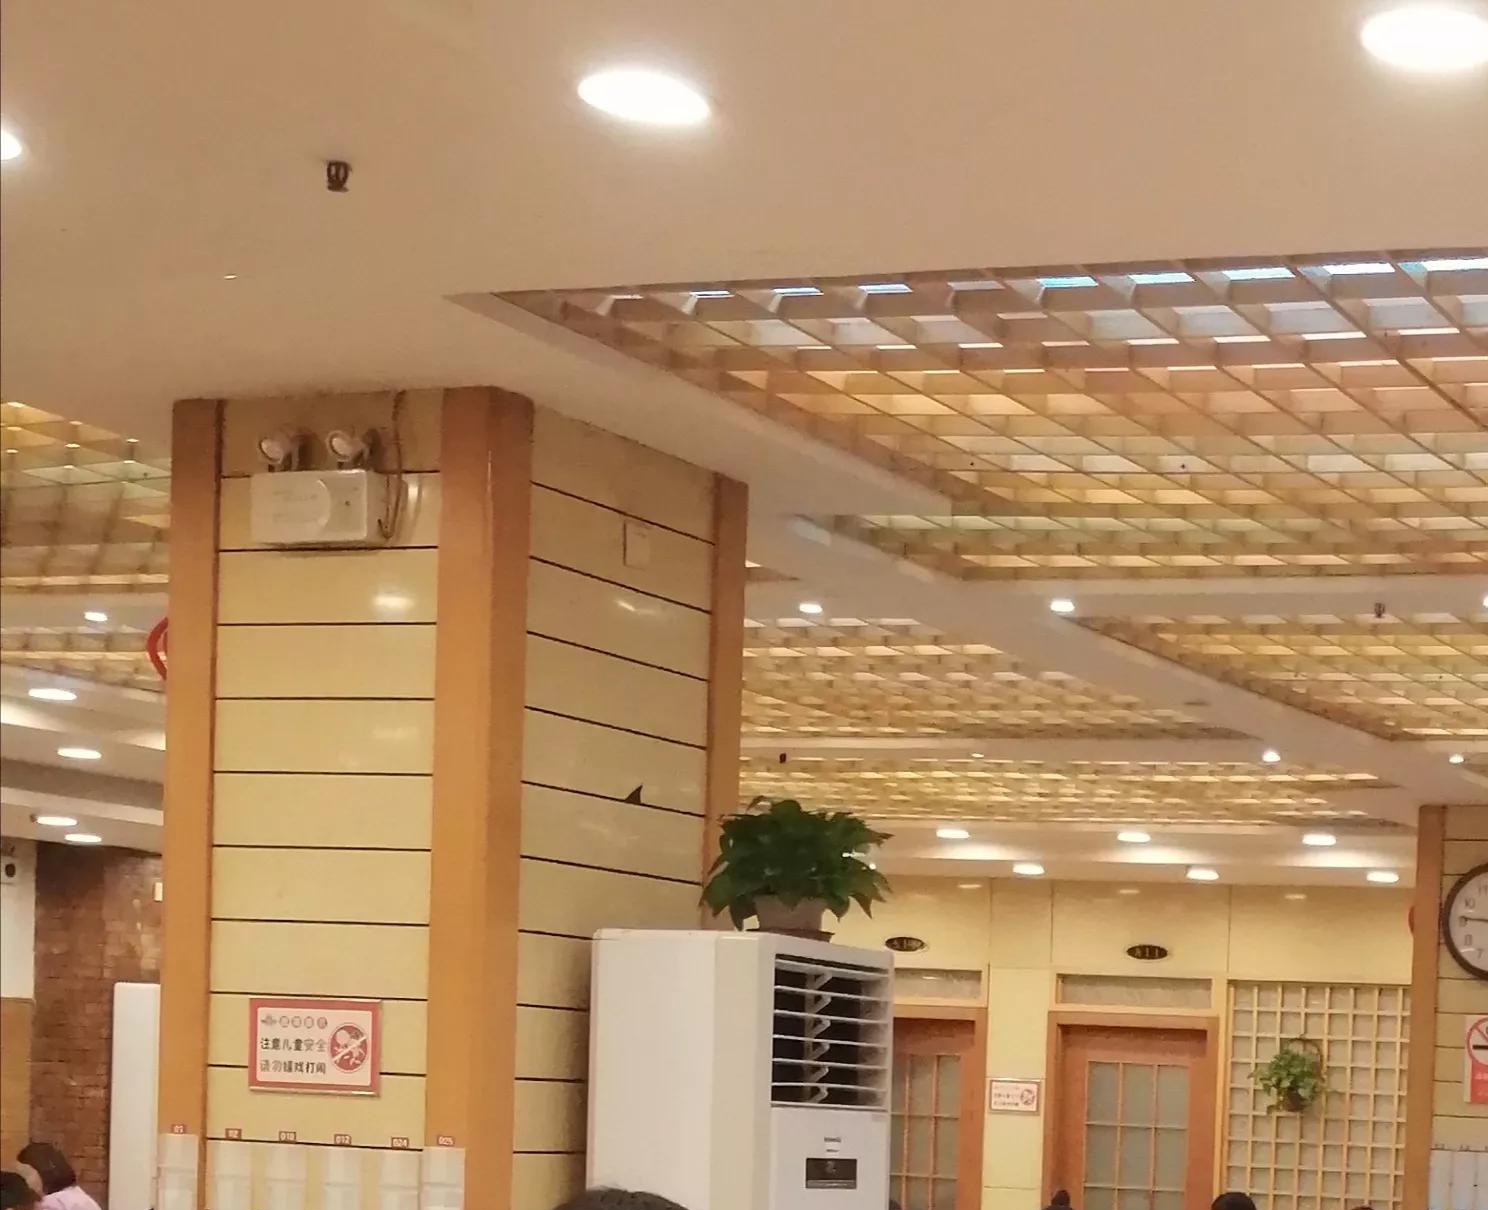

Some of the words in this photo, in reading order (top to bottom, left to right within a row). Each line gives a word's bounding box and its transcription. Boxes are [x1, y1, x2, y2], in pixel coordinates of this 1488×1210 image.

[1478, 885, 1488, 895] 11
[1476, 948, 1484, 958] 7
[260, 1038, 327, 1052] 注意儿童安全
